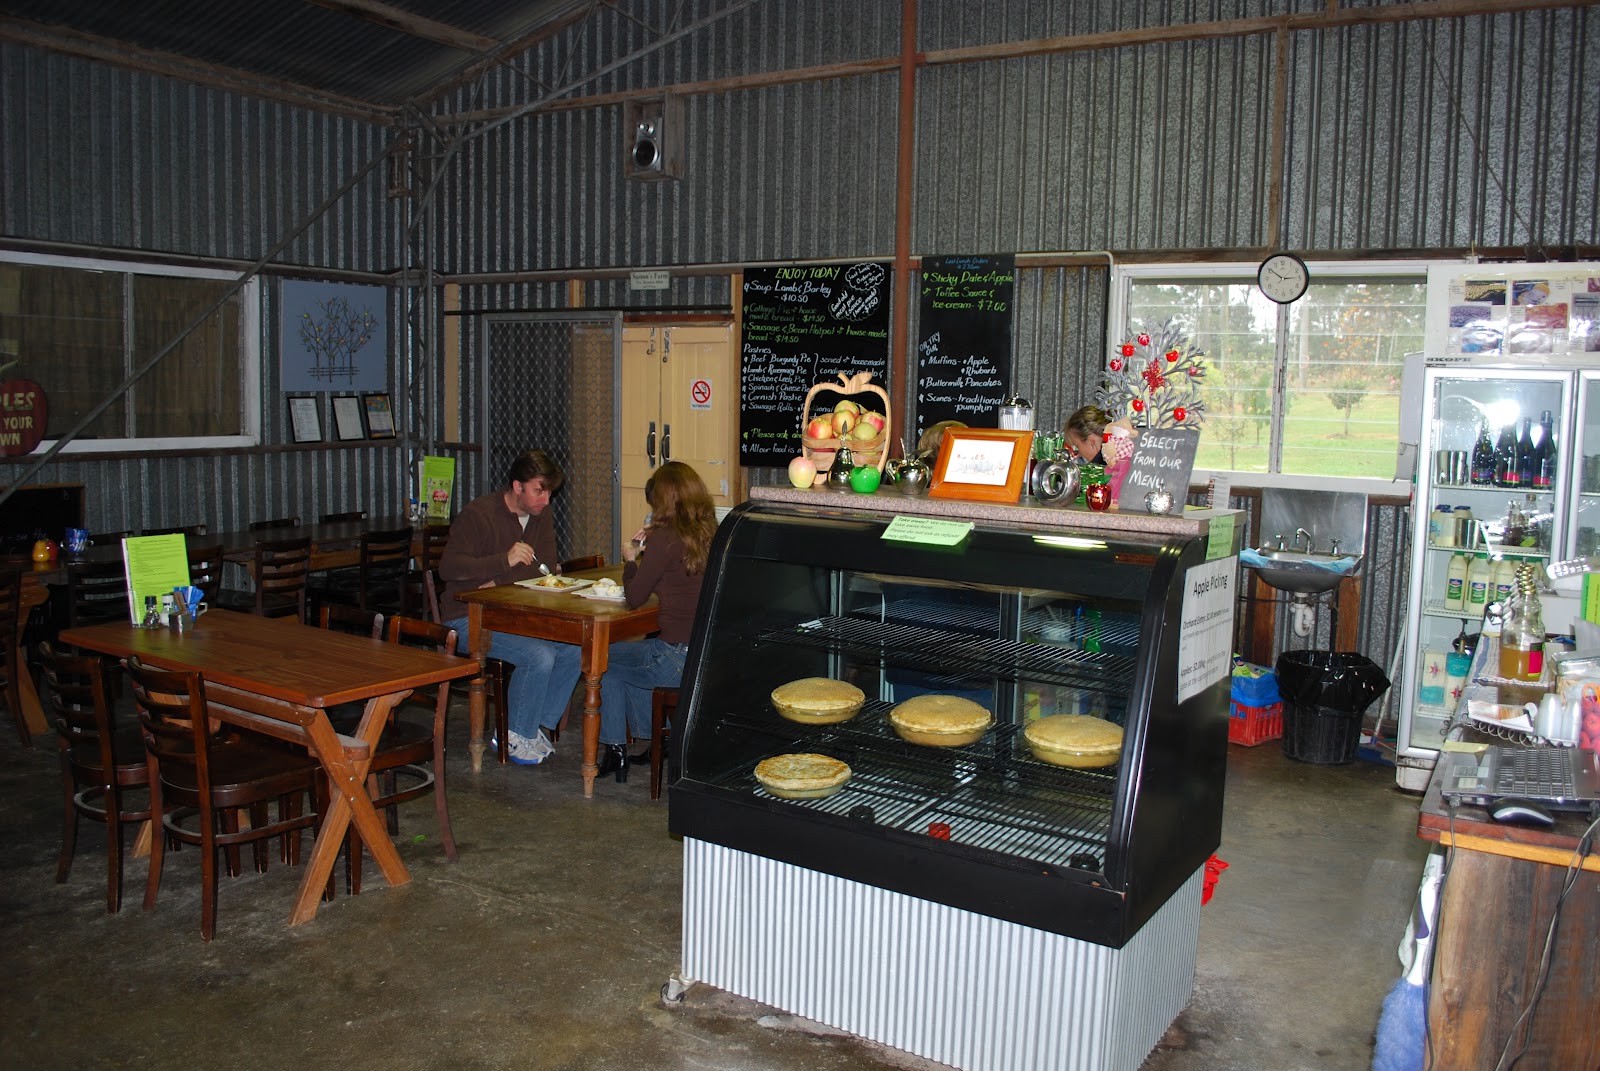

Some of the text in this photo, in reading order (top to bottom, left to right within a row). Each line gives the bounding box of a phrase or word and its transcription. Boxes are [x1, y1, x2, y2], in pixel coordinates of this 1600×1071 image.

[775, 267, 841, 280] ENJOY TODAY
[930, 272, 958, 286] Sticky
[960, 271, 983, 284] Date
[988, 270, 1014, 286] Apple
[803, 281, 831, 298] Barley
[935, 286, 960, 297] Toffee
[962, 286, 987, 297] Sauce
[750, 303, 776, 315] Cottage
[772, 313, 795, 321] bread
[747, 322, 780, 335] Sausage
[787, 323, 808, 334] Bean
[809, 324, 835, 338] Hotpot
[748, 331, 769, 341] bread
[928, 331, 940, 345] TRY
[744, 343, 772, 354] Pastries
[750, 354, 767, 364] Beef
[769, 353, 799, 367] Burgundy
[800, 353, 812, 362] Pie
[820, 356, 842, 364] served
[967, 355, 989, 368] Apple
[768, 364, 795, 375] Rosemary
[796, 366, 807, 374] Pie
[966, 365, 997, 376] Rhubarb
[794, 375, 806, 383] Pie
[925, 376, 1002, 389] Buttermilk Pancakes
[748, 383, 775, 393] Spinach
[780, 384, 801, 392] Cheese
[801, 384, 811, 392] Pie
[0, 391, 35, 411] LES
[748, 390, 803, 401] Cornish Pastie
[926, 392, 1005, 405] Scones traditional
[748, 402, 777, 412] Sausage
[777, 402, 793, 412] Rolls
[956, 404, 993, 414] pumpkin
[4, 416, 33, 429] YOUR
[751, 428, 775, 438] Please
[776, 429, 788, 439] ask
[1140, 432, 1184, 449] SELECT
[772, 443, 787, 453] food
[1133, 451, 1182, 470] FROM OUR
[1193, 574, 1228, 598] Apple Picking
